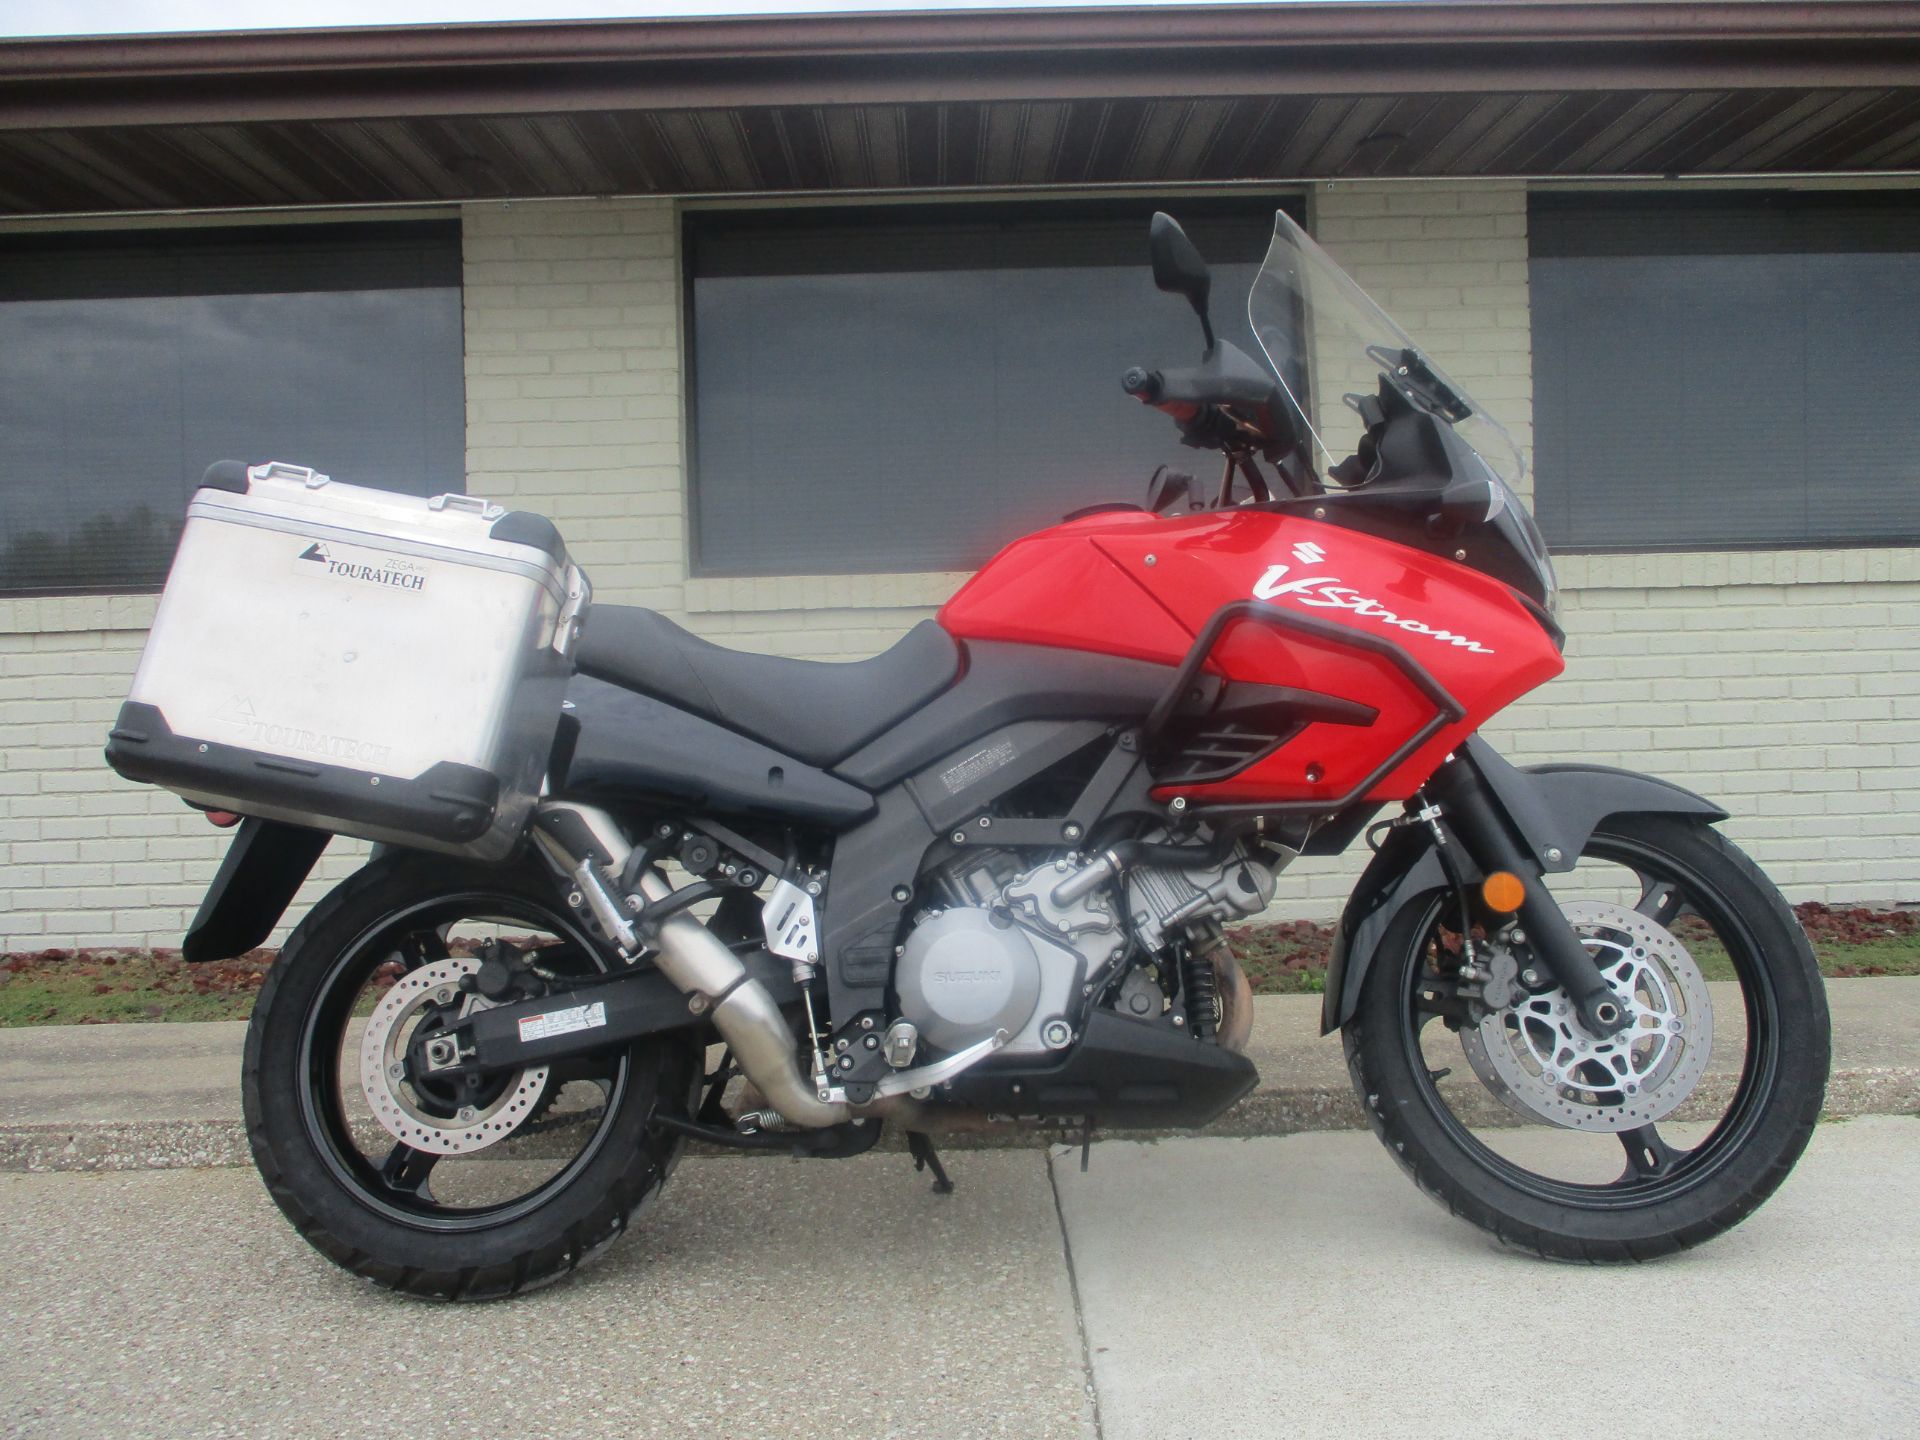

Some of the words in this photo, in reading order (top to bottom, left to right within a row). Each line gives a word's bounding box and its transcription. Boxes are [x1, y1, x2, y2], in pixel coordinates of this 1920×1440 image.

[328, 560, 425, 590] TOURATECH
[385, 558, 414, 571] ZEGA
[252, 721, 392, 767] TOURATECH
[932, 970, 1002, 984] SUZUKI
